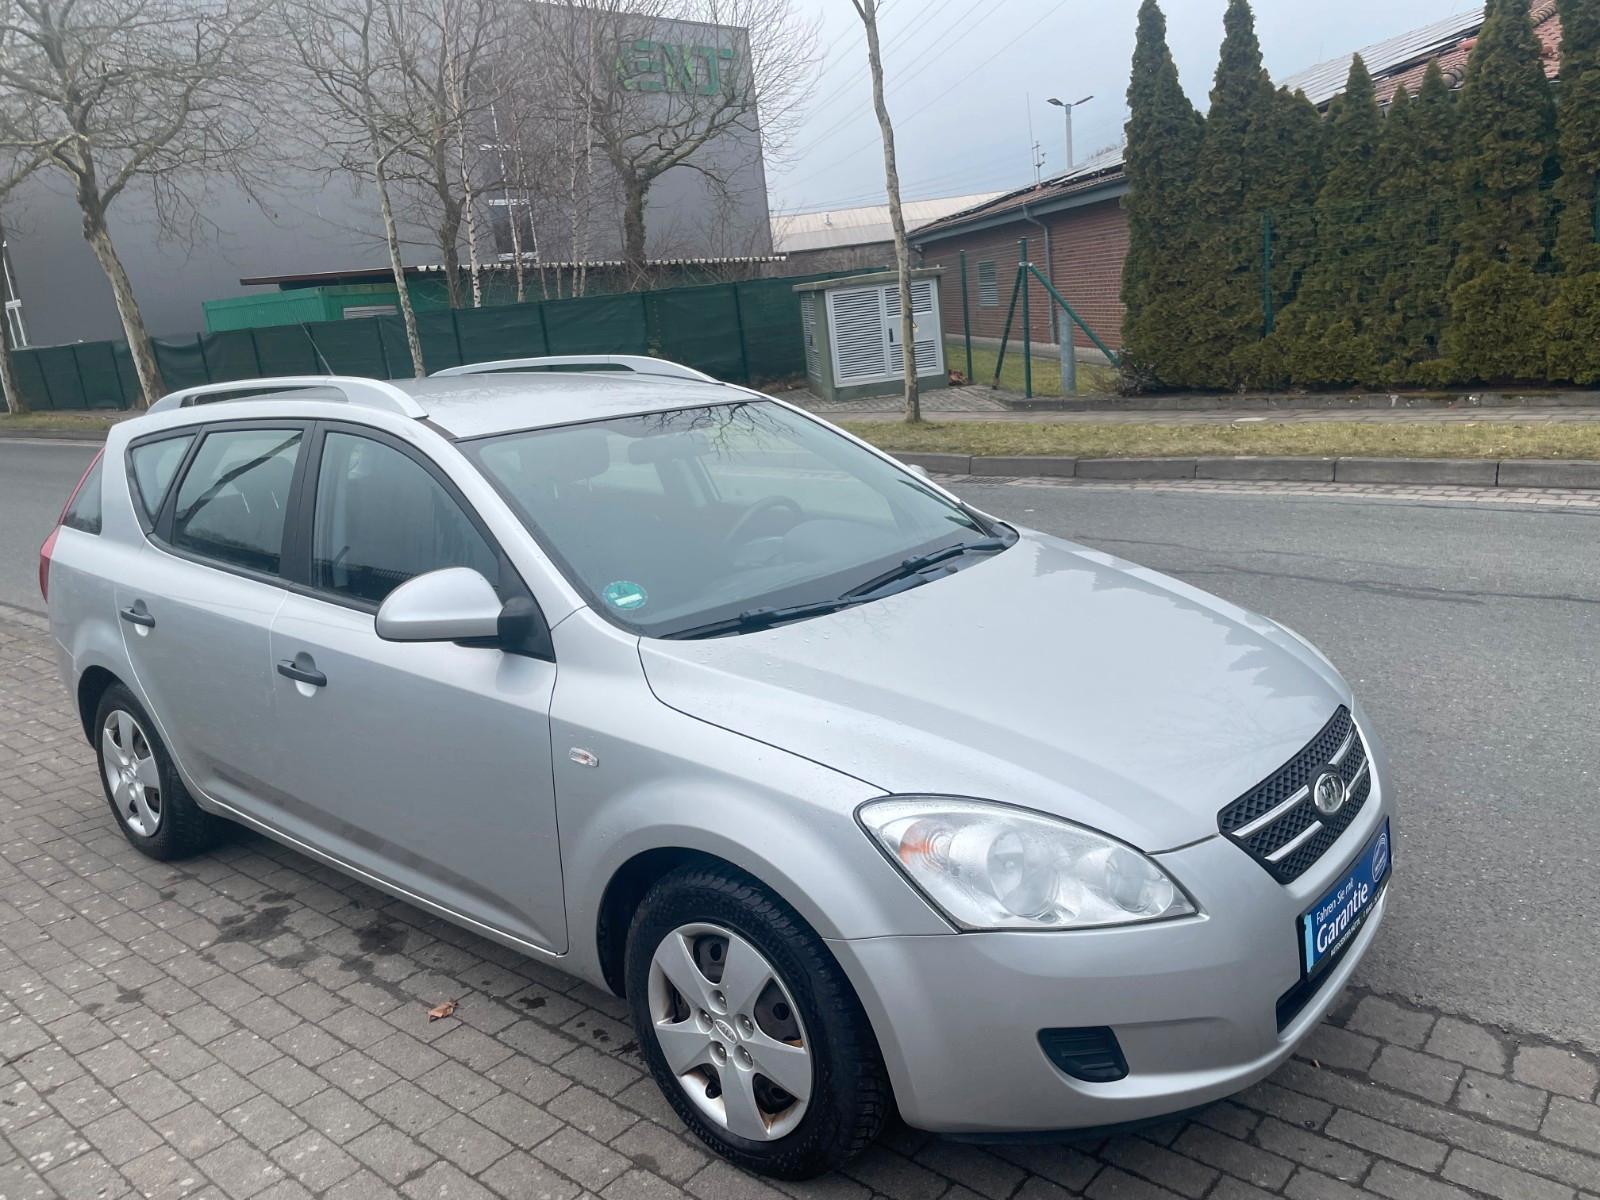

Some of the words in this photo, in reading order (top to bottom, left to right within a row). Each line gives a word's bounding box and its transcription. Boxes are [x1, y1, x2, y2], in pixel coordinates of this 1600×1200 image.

[1316, 899, 1336, 925] Fahren
[1337, 889, 1345, 903] Sie
[1316, 882, 1369, 953] Garantie
